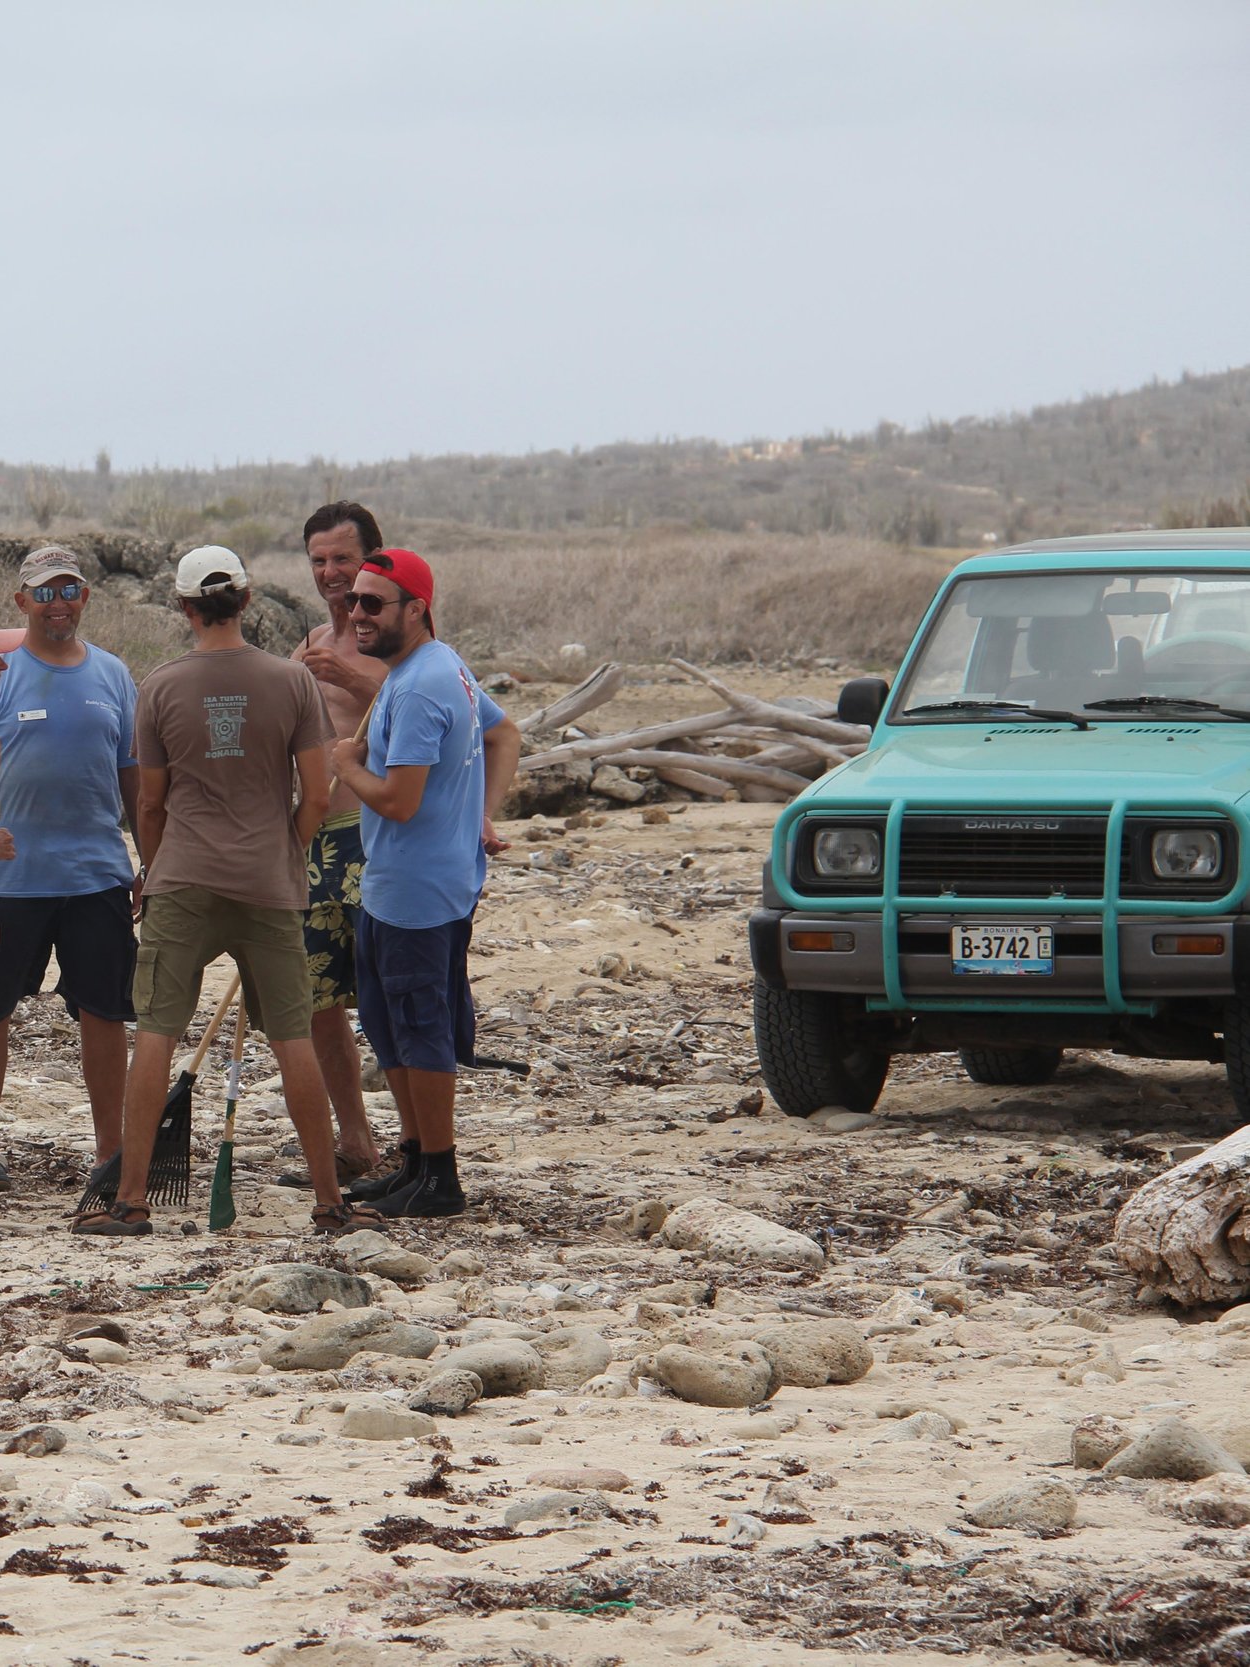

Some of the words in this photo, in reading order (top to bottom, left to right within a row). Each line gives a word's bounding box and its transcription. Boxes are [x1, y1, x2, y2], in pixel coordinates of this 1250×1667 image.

[205, 748, 245, 759] BONAIRE
[964, 820, 1060, 830] DAIHATSU
[961, 936, 1030, 959] B-3742
